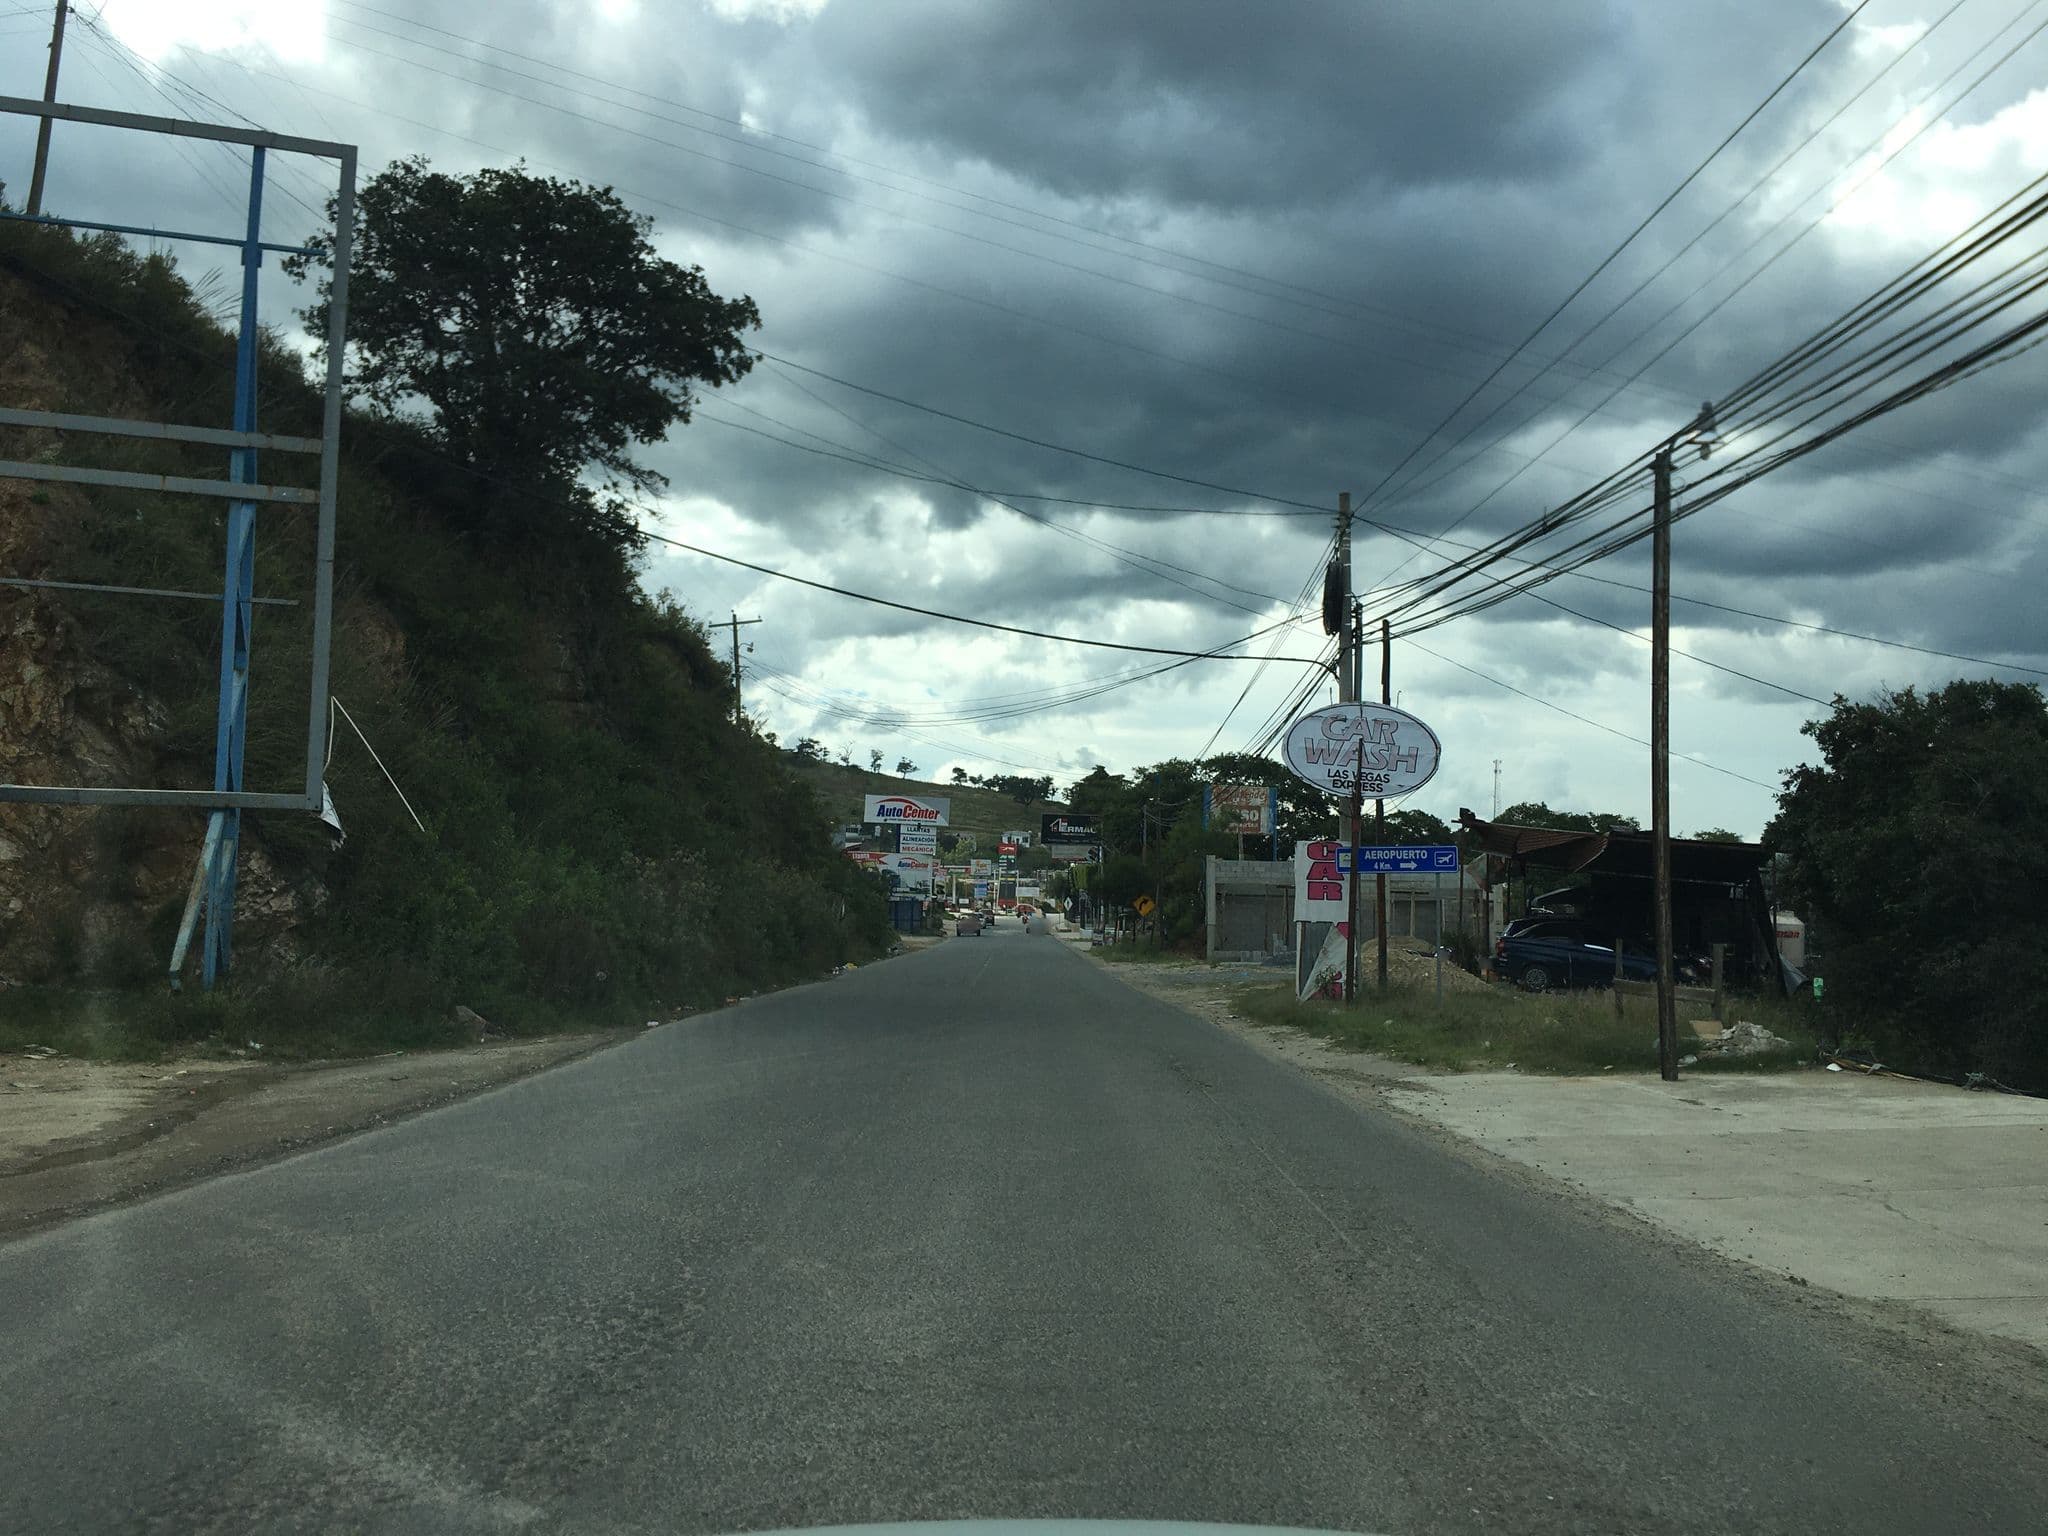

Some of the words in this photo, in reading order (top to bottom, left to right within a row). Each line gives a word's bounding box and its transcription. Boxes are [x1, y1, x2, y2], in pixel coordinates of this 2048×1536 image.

[1321, 714, 1399, 745] CAR
[1304, 737, 1419, 773] WASH
[1327, 768, 1349, 779] LAS
[1352, 771, 1390, 783] VEGAS
[876, 804, 940, 819] AutoCenter
[1364, 849, 1428, 860] AEROPUERTO
[1306, 842, 1345, 901] CAR
[1373, 861, 1379, 870] 4
